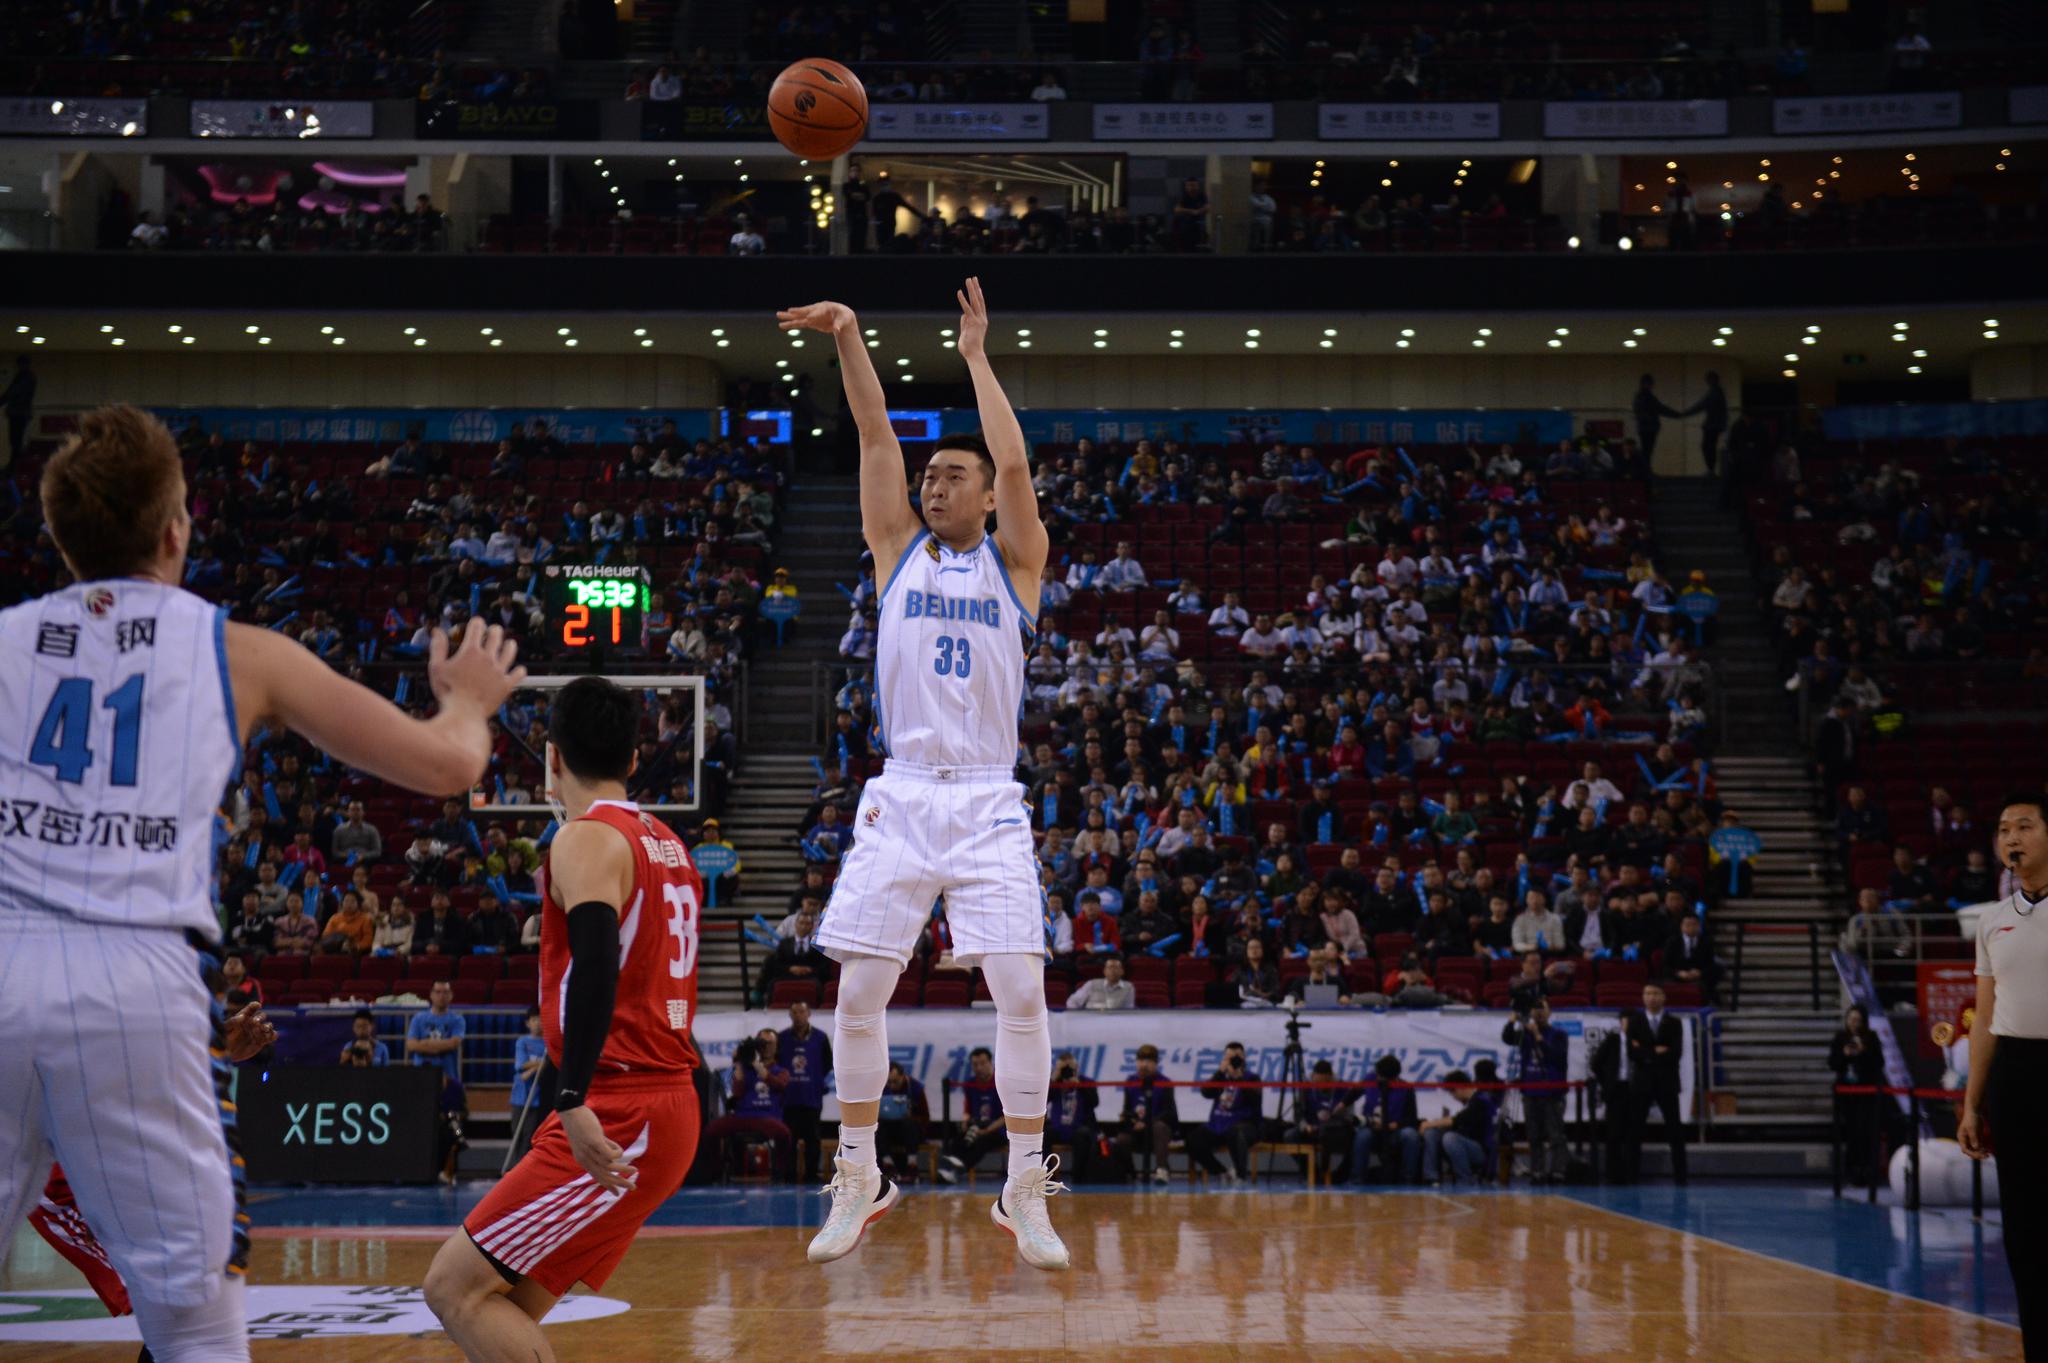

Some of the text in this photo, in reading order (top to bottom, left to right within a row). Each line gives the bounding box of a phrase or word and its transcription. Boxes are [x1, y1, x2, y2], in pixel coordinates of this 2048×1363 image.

[684, 106, 769, 124] BRAV
[904, 588, 1001, 630] BEIJING
[36, 616, 157, 658] 首钢
[934, 635, 971, 679] 33
[29, 672, 145, 787] 41
[0, 799, 177, 852] 汉密尔顿
[282, 1101, 392, 1145] XESS
